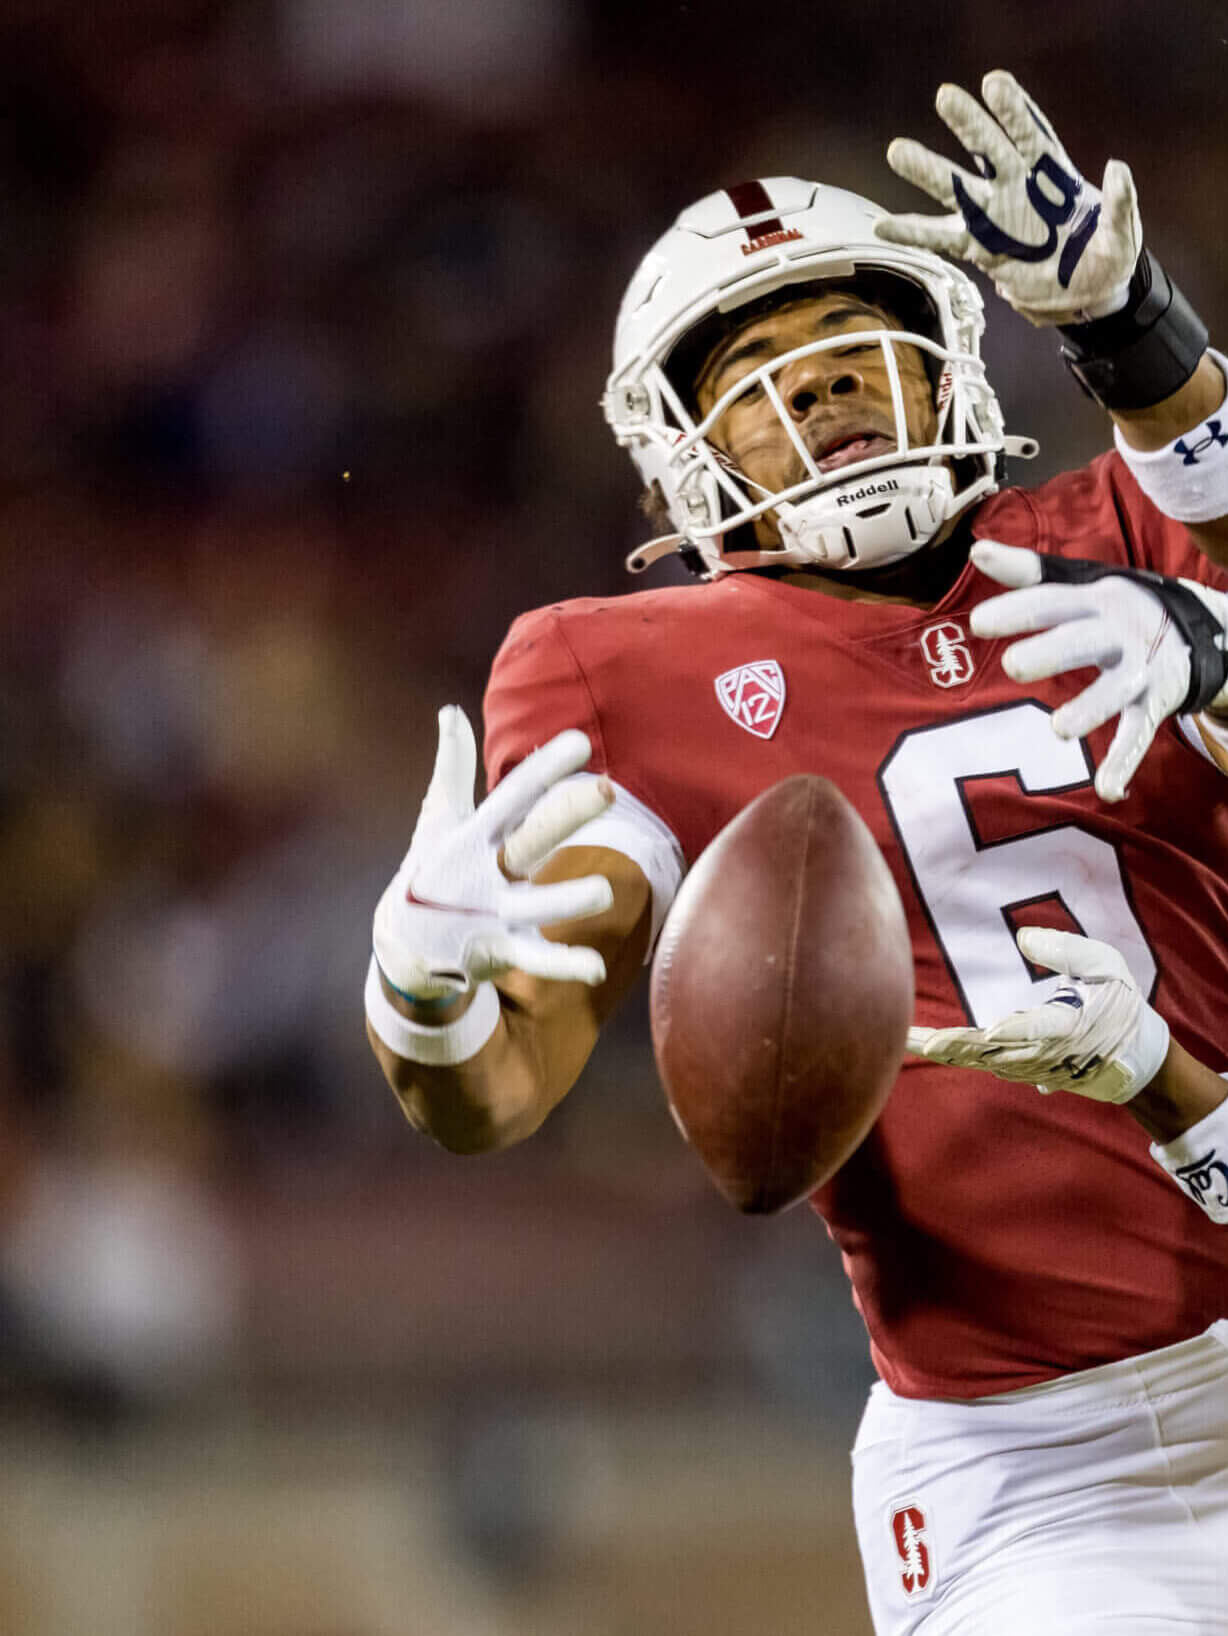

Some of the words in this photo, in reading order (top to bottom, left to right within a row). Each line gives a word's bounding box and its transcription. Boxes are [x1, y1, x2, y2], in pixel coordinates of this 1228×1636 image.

[836, 479, 900, 508] Riddell
[717, 663, 781, 717] PAC
[741, 692, 778, 727] 12
[876, 697, 1158, 1032] 6
